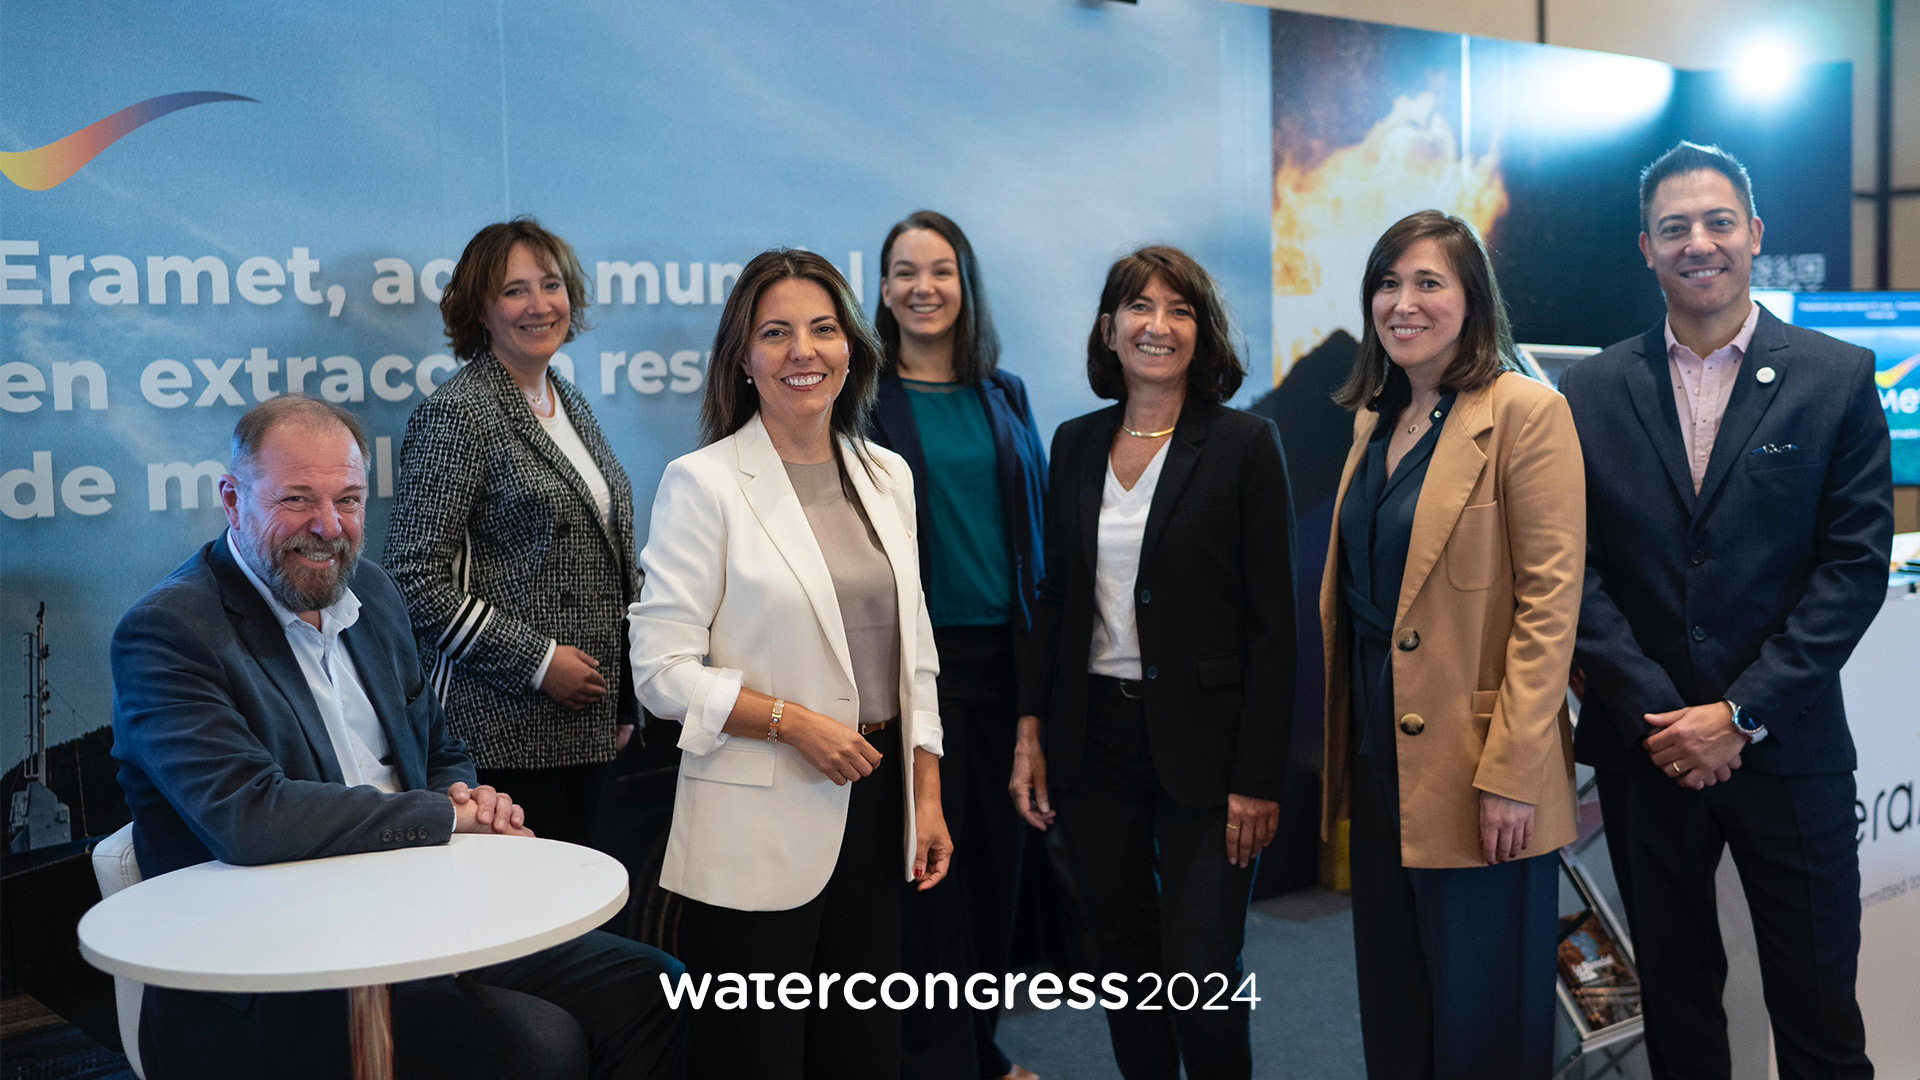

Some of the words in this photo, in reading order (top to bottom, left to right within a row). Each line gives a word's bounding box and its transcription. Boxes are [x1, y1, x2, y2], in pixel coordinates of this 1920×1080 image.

[0, 240, 346, 317] Eramet,
[0, 360, 108, 413] en
[0, 450, 116, 520] de
